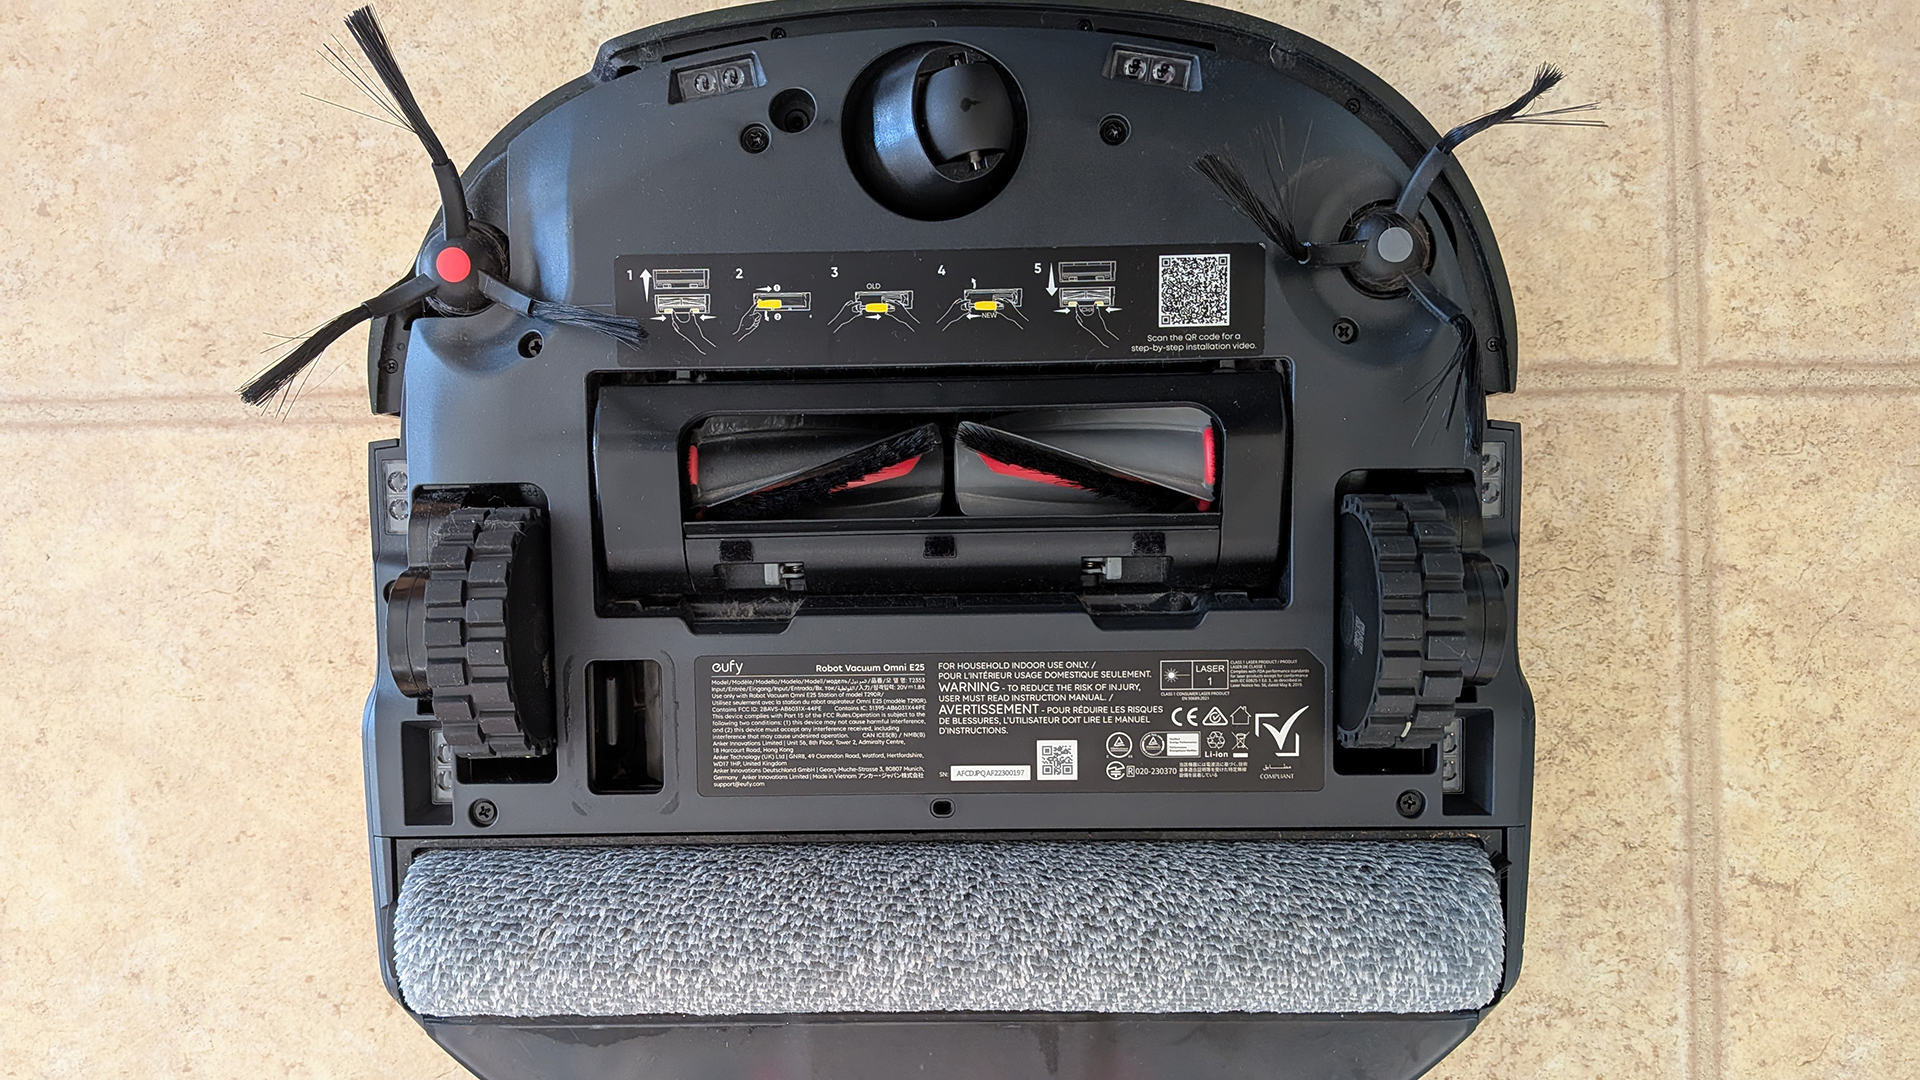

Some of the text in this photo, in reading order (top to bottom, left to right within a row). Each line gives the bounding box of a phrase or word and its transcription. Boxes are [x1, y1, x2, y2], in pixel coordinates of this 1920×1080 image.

[735, 268, 744, 279] 2
[831, 267, 839, 278] 3
[938, 265, 946, 276] 4
[1034, 263, 1041, 274] 5
[627, 270, 633, 280] 1
[1131, 344, 1184, 352] step-by-step
[712, 660, 743, 675] eufy
[1195, 664, 1225, 672] LASER
[938, 682, 999, 691] WARNING
[1207, 677, 1212, 686] 1
[938, 704, 1039, 714] AVERTISSEMENT
[1072, 704, 1107, 713] RÉDUIRE
[952, 716, 1001, 725] BLESSURES,
